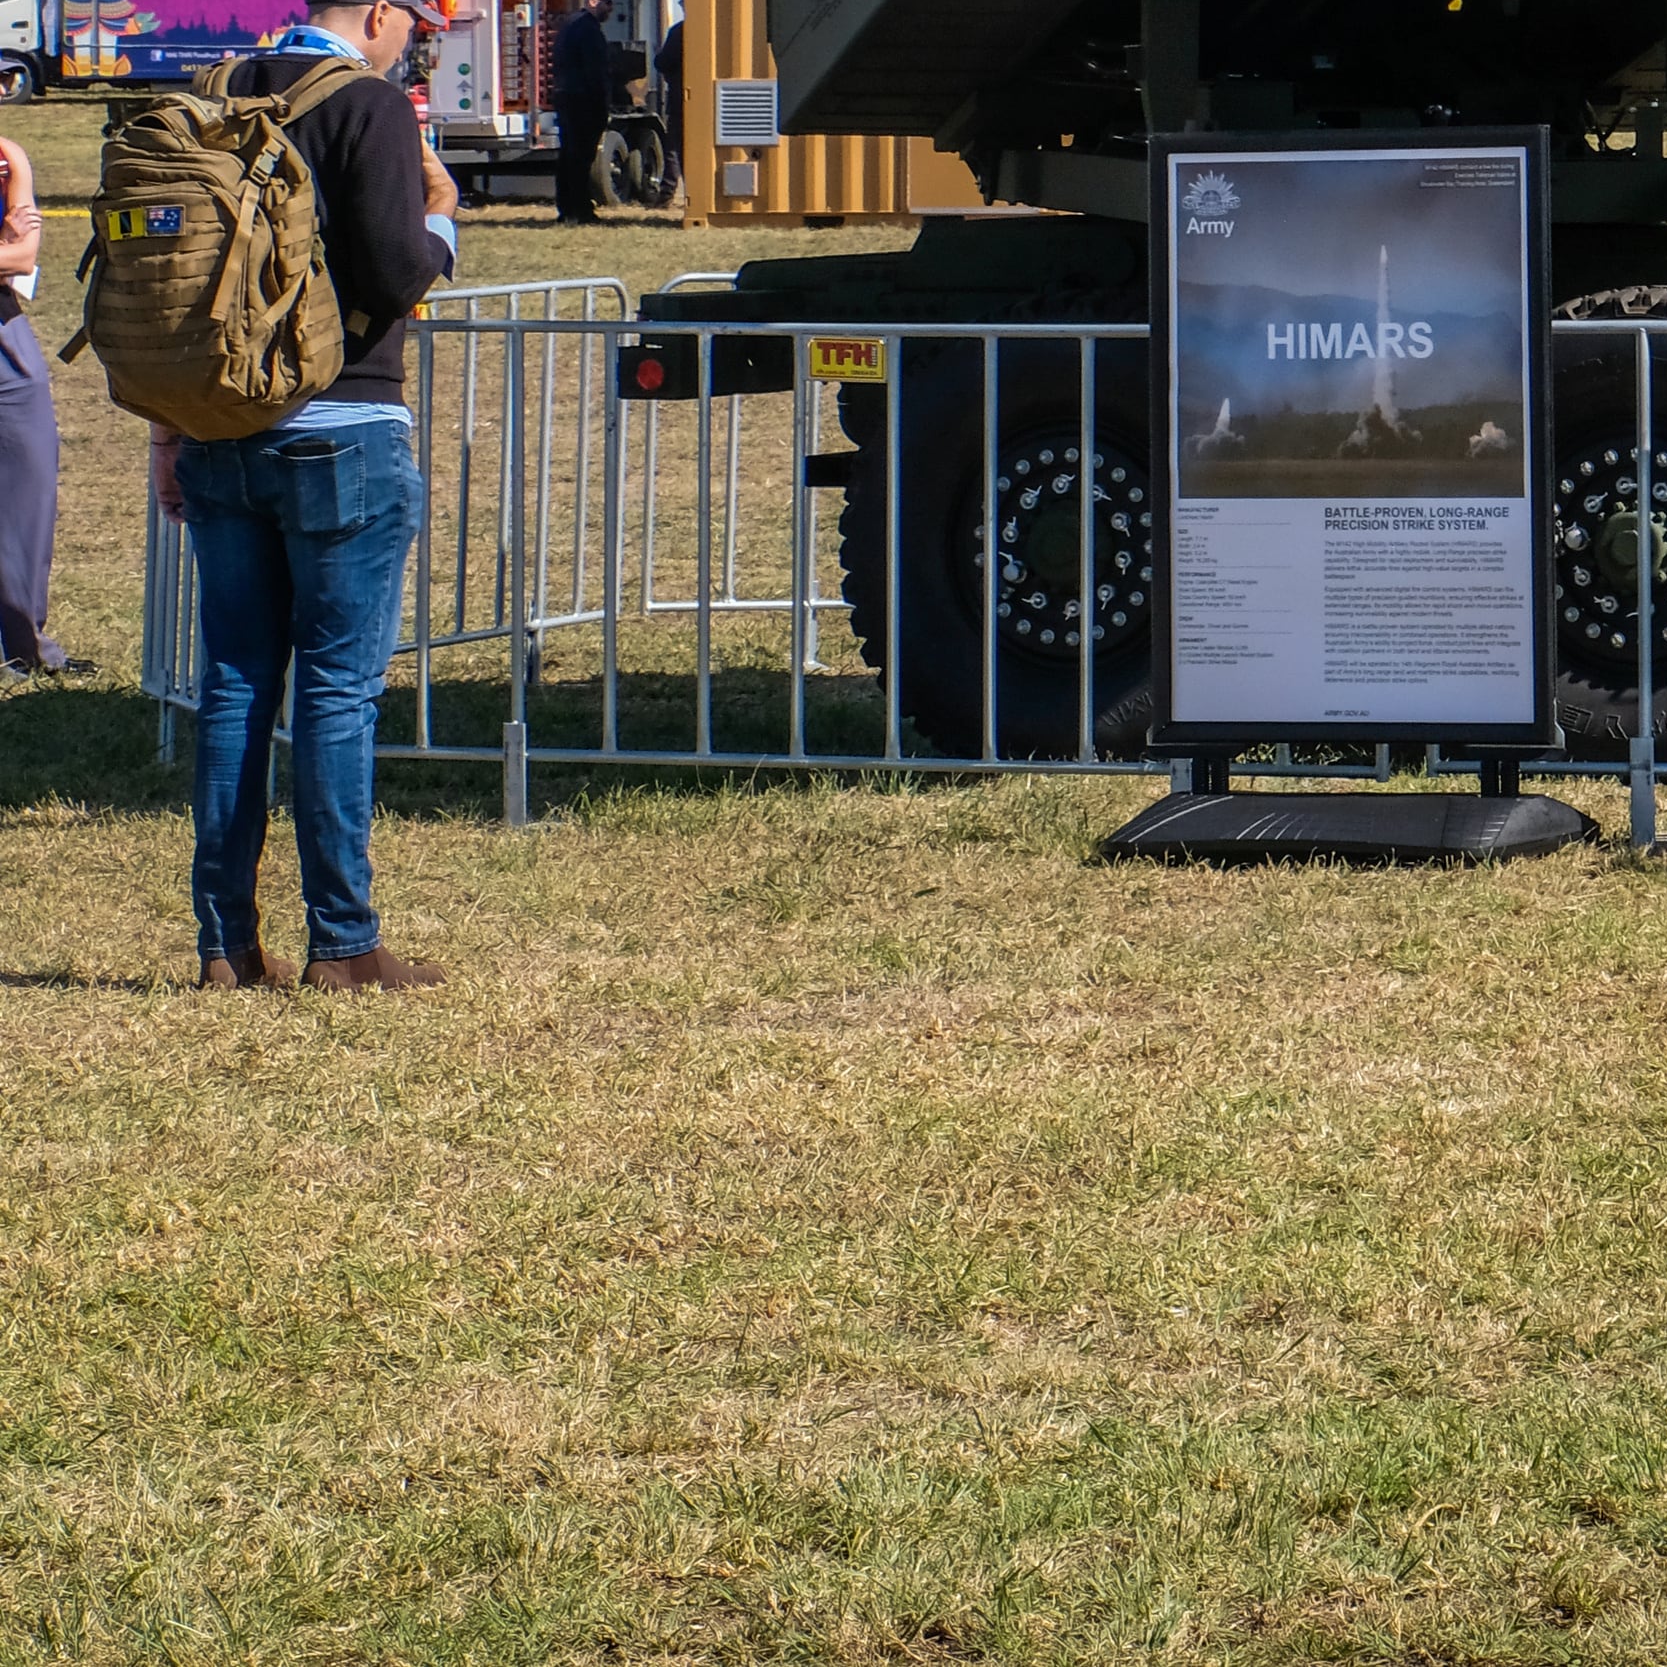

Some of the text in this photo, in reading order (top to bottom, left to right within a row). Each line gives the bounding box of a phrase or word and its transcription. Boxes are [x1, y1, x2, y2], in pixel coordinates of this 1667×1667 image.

[1187, 218, 1234, 237] Army
[1267, 322, 1434, 360] HIMARS
[817, 342, 872, 366] TFH
[1324, 507, 1510, 519] BATTLE-PROVEN, LONG-RANGE
[1324, 520, 1488, 530] PRECISION STRIKE SYSTEM.
